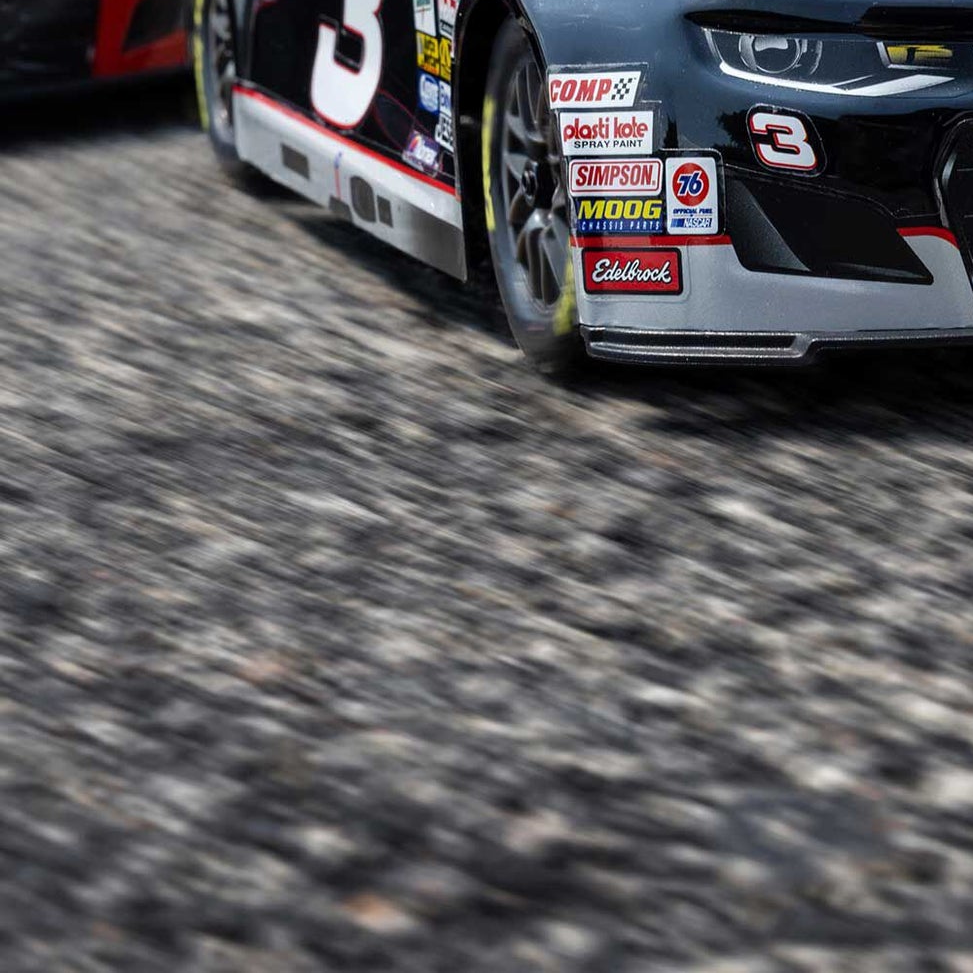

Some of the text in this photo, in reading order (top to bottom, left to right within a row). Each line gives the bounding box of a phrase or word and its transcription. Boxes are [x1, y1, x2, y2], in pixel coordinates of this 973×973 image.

[549, 78, 612, 102] COMP
[563, 116, 649, 142] plasti kote
[750, 112, 819, 170] 3
[574, 139, 643, 149] SPRAY PAINT
[676, 171, 704, 196] 76
[578, 199, 663, 220] MOOG
[581, 221, 660, 231] CHASSIS PARTS
[683, 217, 712, 228] NASCAR
[591, 258, 672, 283] Edelbrock
